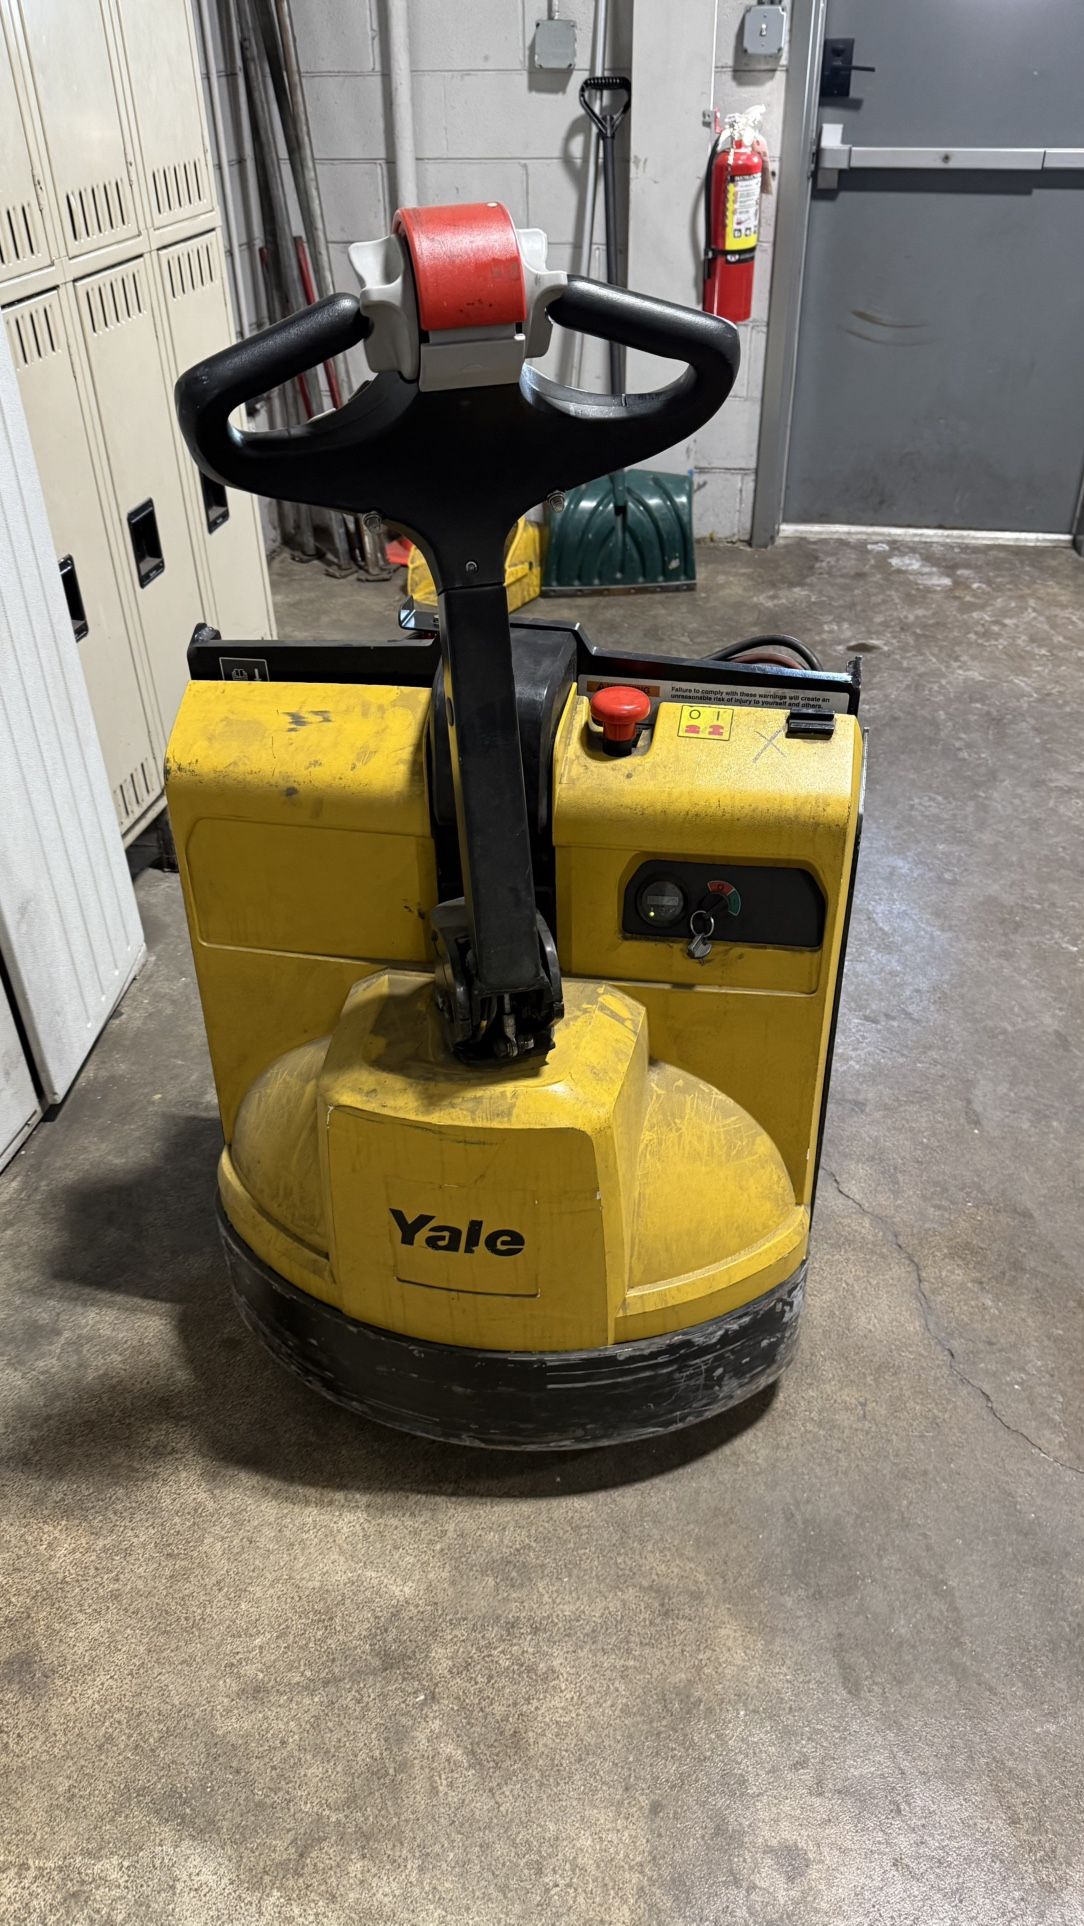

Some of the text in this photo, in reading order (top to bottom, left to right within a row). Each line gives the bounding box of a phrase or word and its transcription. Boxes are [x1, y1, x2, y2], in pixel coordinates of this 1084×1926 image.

[671, 686, 693, 694] Failure
[701, 689, 724, 697] comply
[758, 692, 787, 701] warnings
[671, 693, 713, 701] unreasonable
[734, 697, 752, 705] injury
[389, 1207, 526, 1257] Yale
